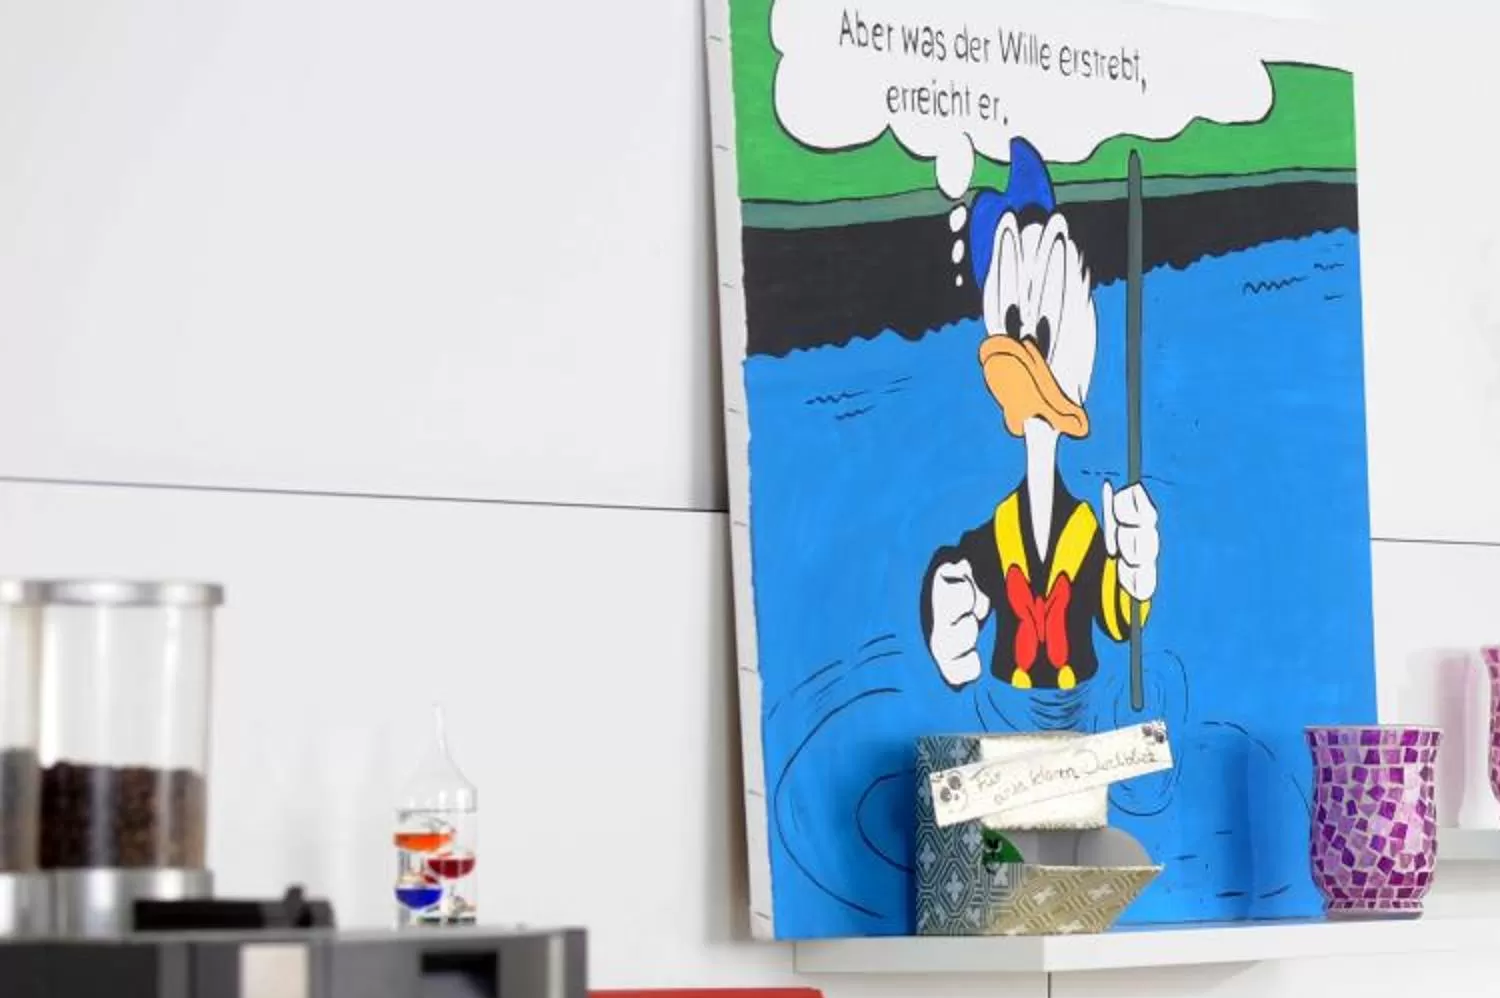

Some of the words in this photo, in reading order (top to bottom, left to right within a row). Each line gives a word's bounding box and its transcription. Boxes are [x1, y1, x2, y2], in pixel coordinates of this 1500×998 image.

[839, 9, 894, 51] Aber
[902, 24, 946, 61] was
[953, 24, 990, 63] der
[999, 27, 1051, 71] Wille
[1058, 44, 1147, 94] erstrebt,
[886, 80, 970, 117] erreicht
[978, 93, 1008, 125] er.
